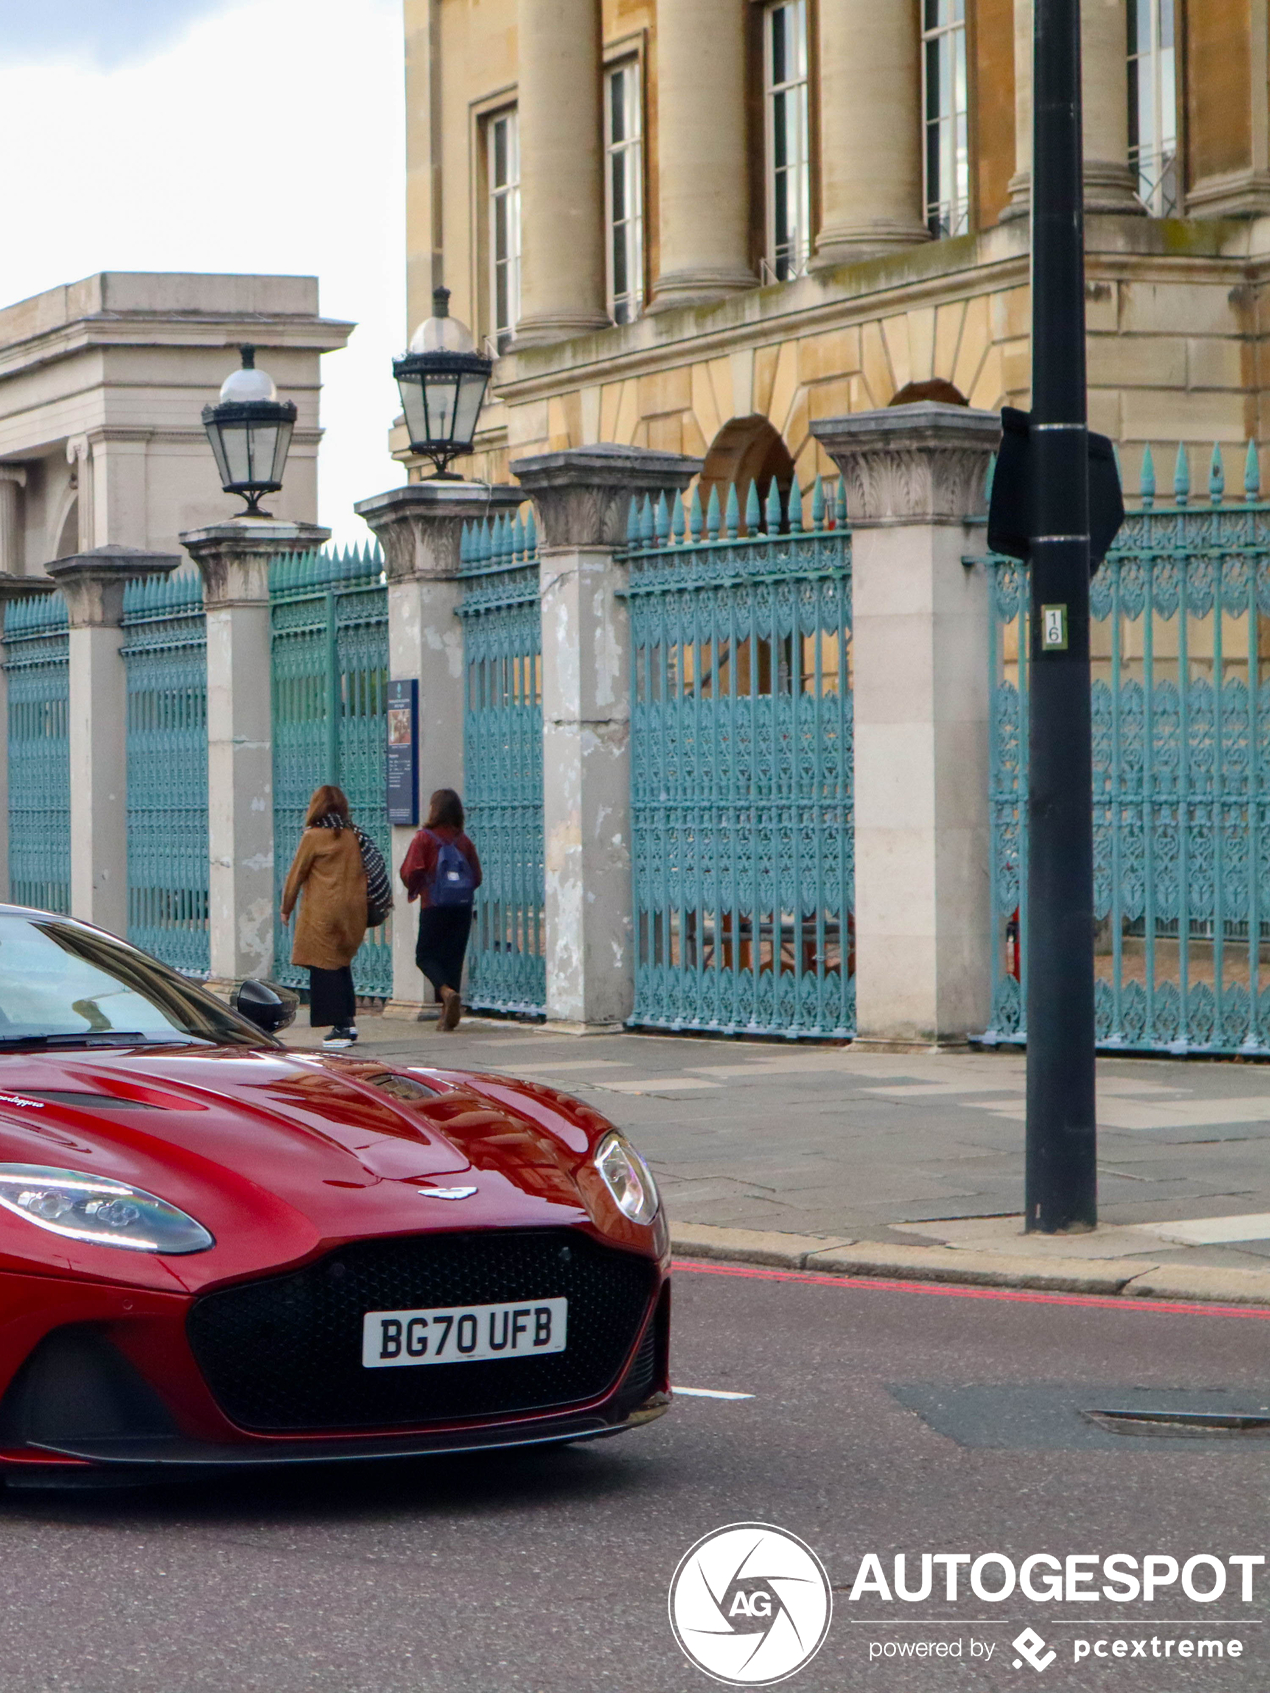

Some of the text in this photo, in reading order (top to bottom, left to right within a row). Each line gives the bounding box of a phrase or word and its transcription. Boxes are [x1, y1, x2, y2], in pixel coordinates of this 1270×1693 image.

[1048, 611, 1059, 641] 16
[379, 1306, 552, 1359] BG70 UFB
